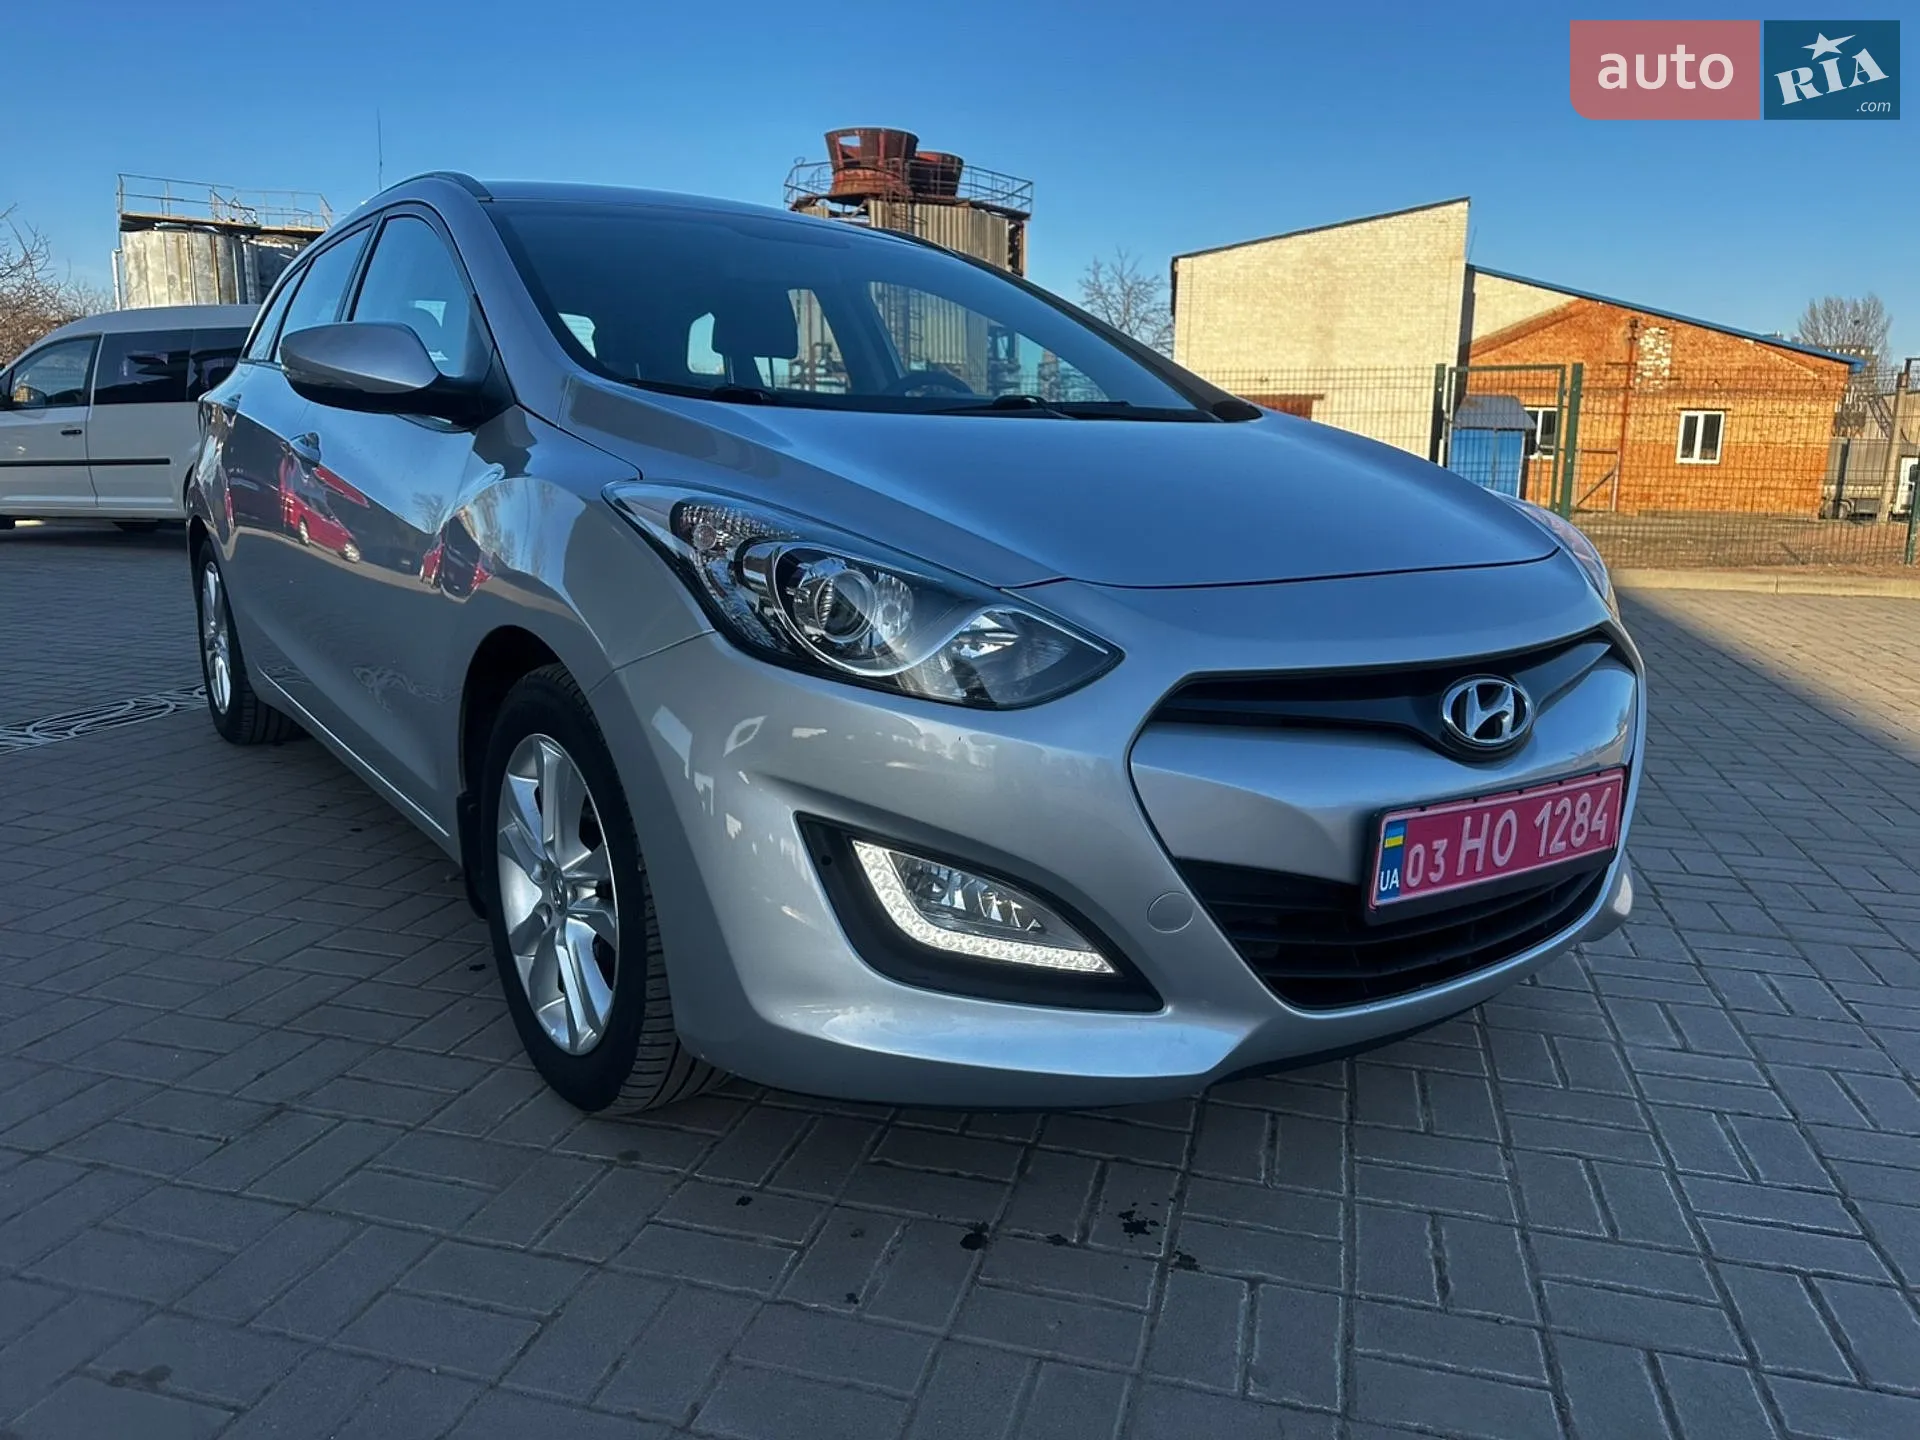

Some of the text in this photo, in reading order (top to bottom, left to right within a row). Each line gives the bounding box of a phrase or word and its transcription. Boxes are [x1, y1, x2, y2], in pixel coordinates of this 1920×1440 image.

[1406, 787, 1612, 888] 03 HO 1284
[1380, 868, 1400, 891] UA
